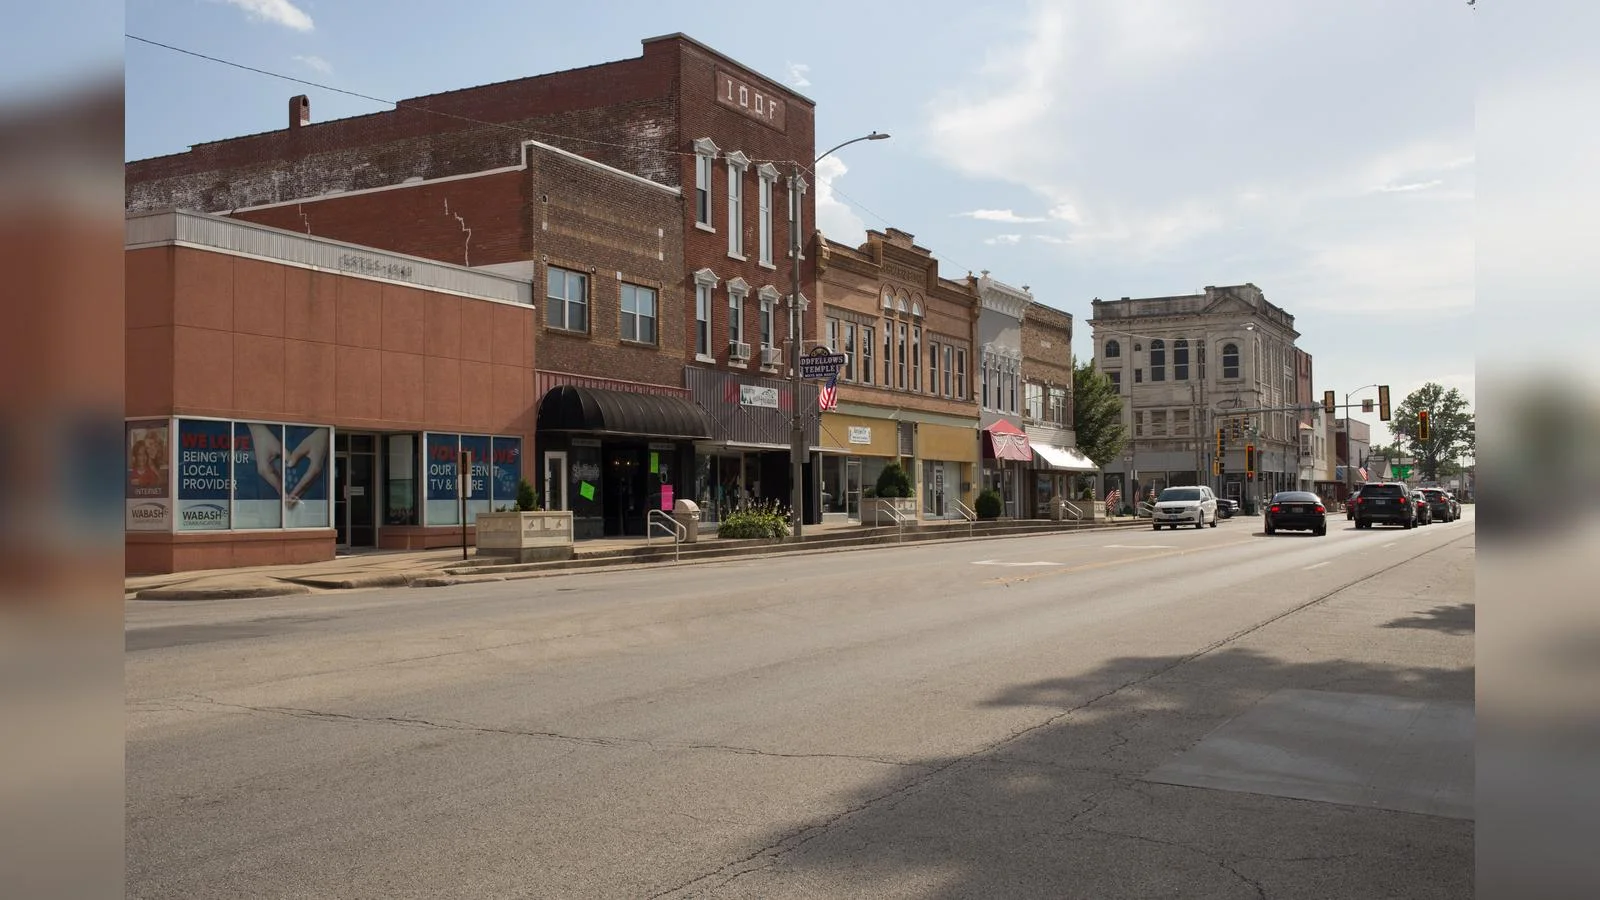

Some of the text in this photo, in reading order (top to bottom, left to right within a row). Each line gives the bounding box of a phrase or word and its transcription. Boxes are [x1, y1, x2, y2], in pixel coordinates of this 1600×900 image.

[801, 356, 843, 365] DDFELLOWS
[182, 433, 206, 448] WE
[183, 451, 217, 463] BEING
[183, 465, 220, 476] LOCAL
[430, 464, 451, 476] OUR
[430, 479, 444, 490] TV
[445, 479, 453, 490] &
[131, 509, 164, 519] WABASH
[182, 510, 222, 520] WABASH
